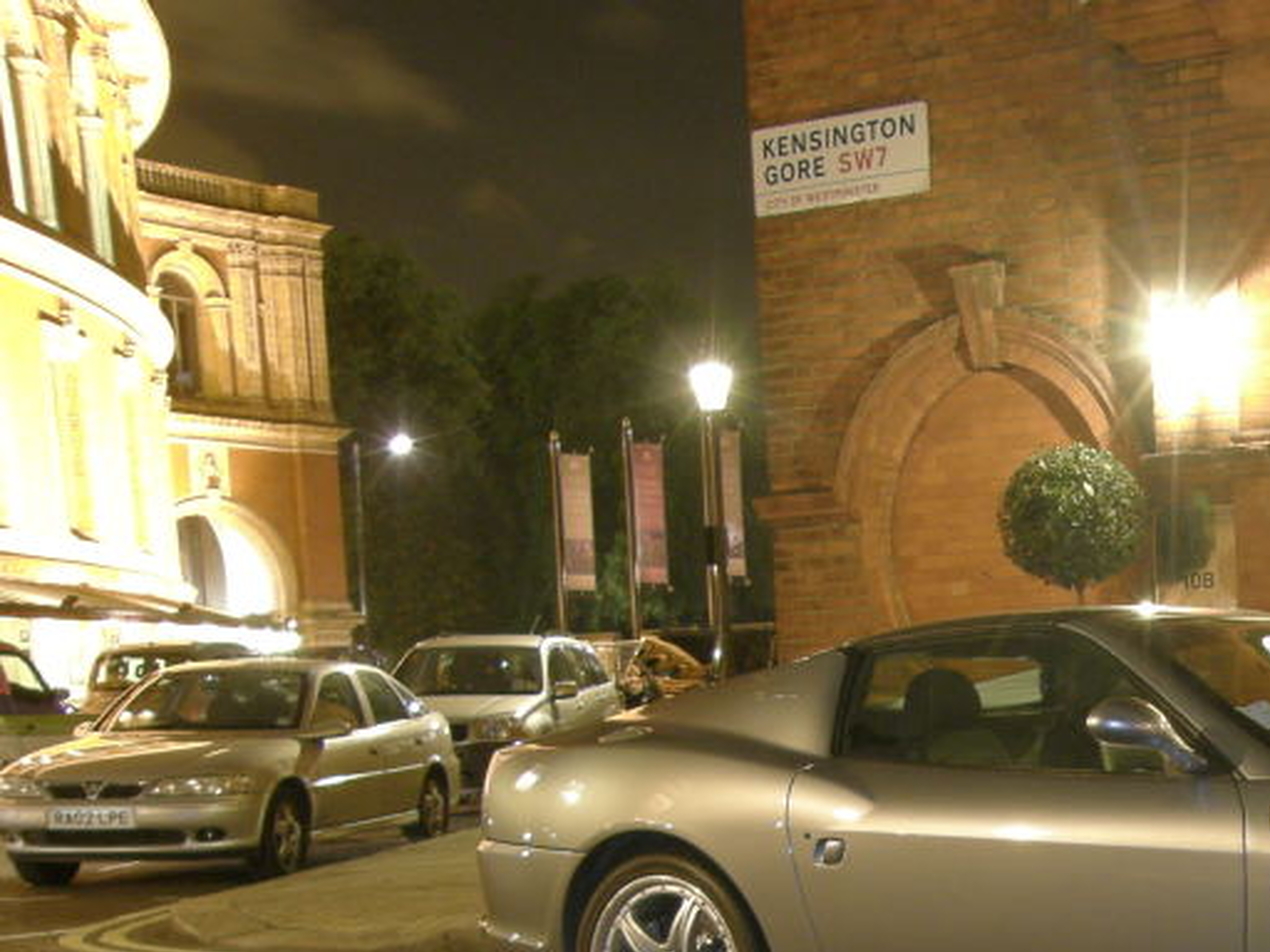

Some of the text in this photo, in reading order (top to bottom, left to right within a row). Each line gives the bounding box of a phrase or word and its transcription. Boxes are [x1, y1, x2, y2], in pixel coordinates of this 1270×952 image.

[762, 113, 916, 159] KENSINGTON
[764, 146, 887, 186] GORE SW7
